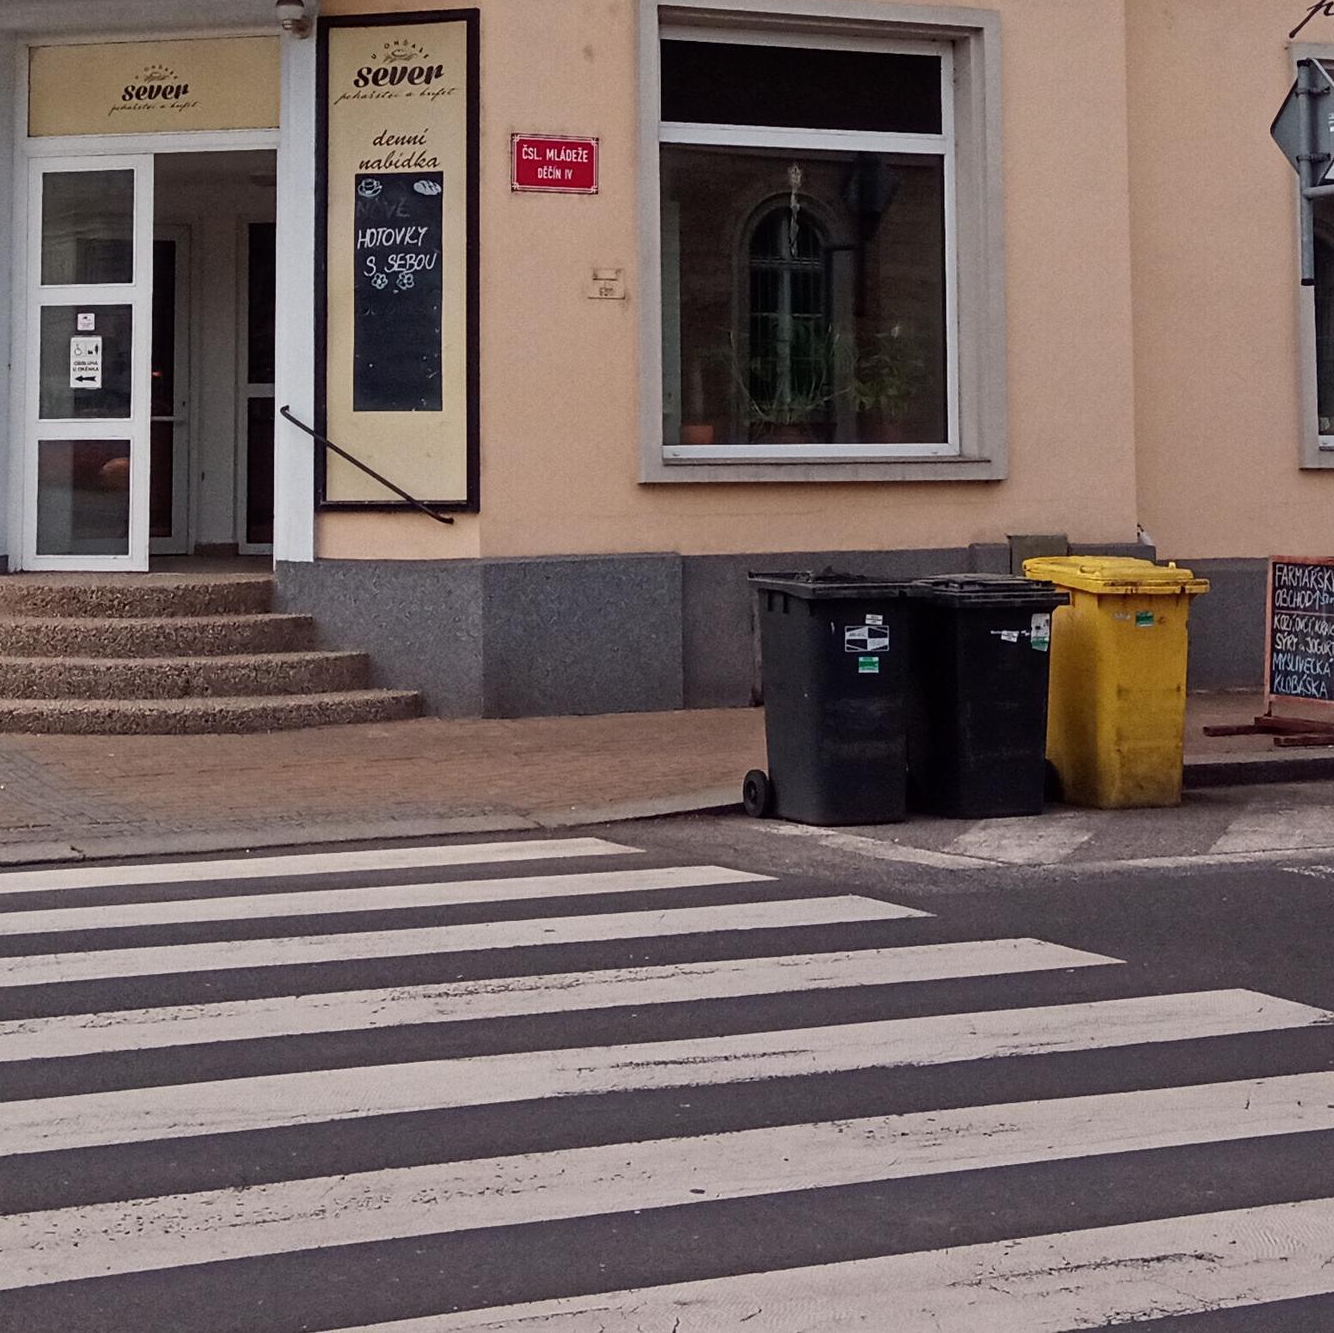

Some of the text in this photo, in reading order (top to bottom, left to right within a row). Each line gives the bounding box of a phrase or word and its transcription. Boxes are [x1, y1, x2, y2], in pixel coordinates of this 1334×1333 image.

[353, 64, 445, 88] sever
[121, 83, 190, 102] sever
[372, 128, 429, 148] denní
[358, 149, 441, 171] nabídka
[521, 144, 589, 163] ČSL. MLÁDEŽE
[537, 165, 573, 180] DĚČÍN IV
[356, 226, 429, 250] HOTOVKY
[363, 253, 437, 277] S SEBOU
